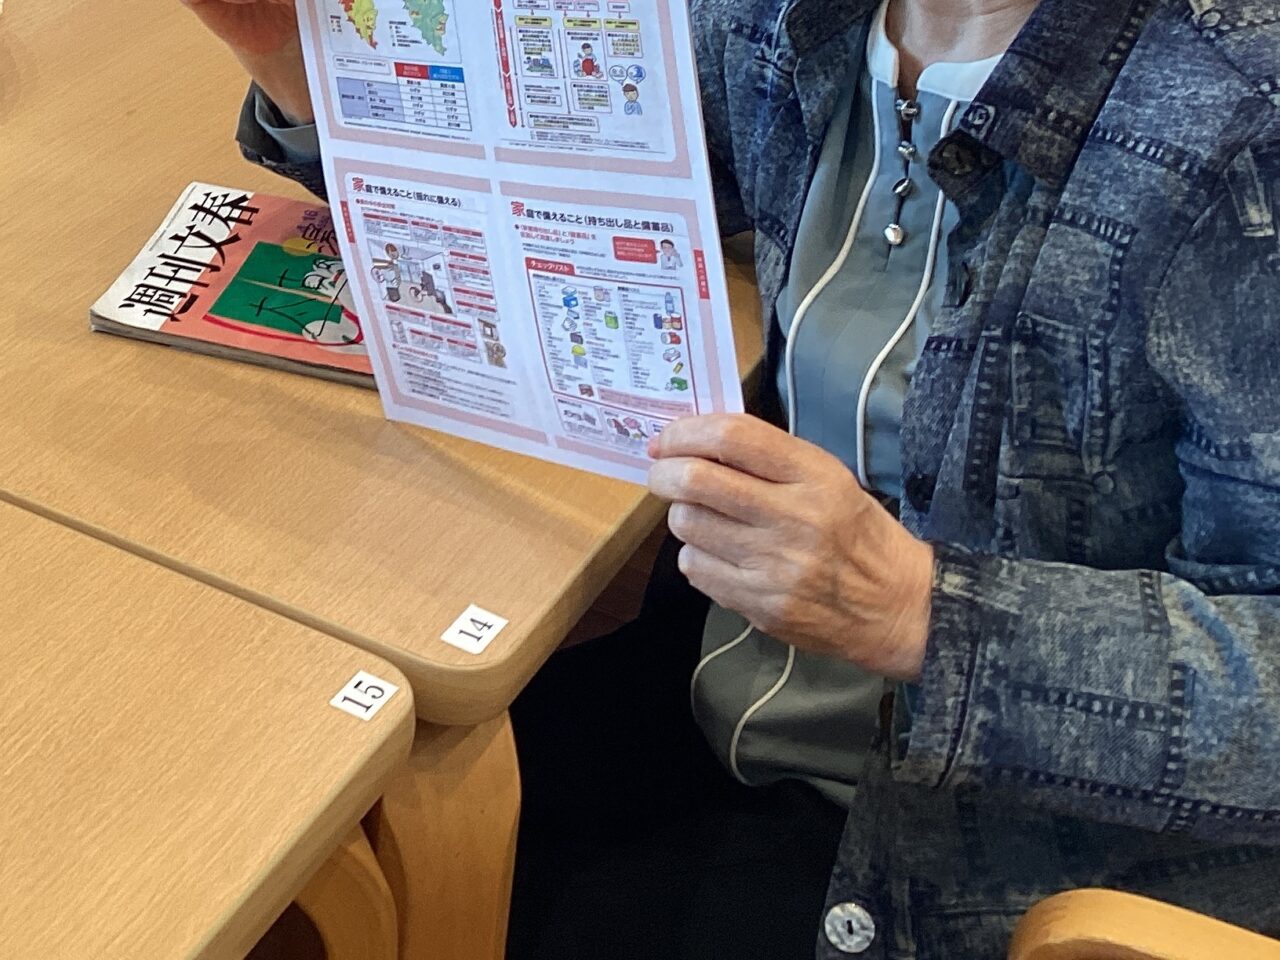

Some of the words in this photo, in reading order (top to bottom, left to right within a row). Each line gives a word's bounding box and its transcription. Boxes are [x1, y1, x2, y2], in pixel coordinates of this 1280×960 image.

[118, 191, 260, 323] 週刊文春
[458, 617, 494, 642] 14
[341, 679, 386, 713] 15
